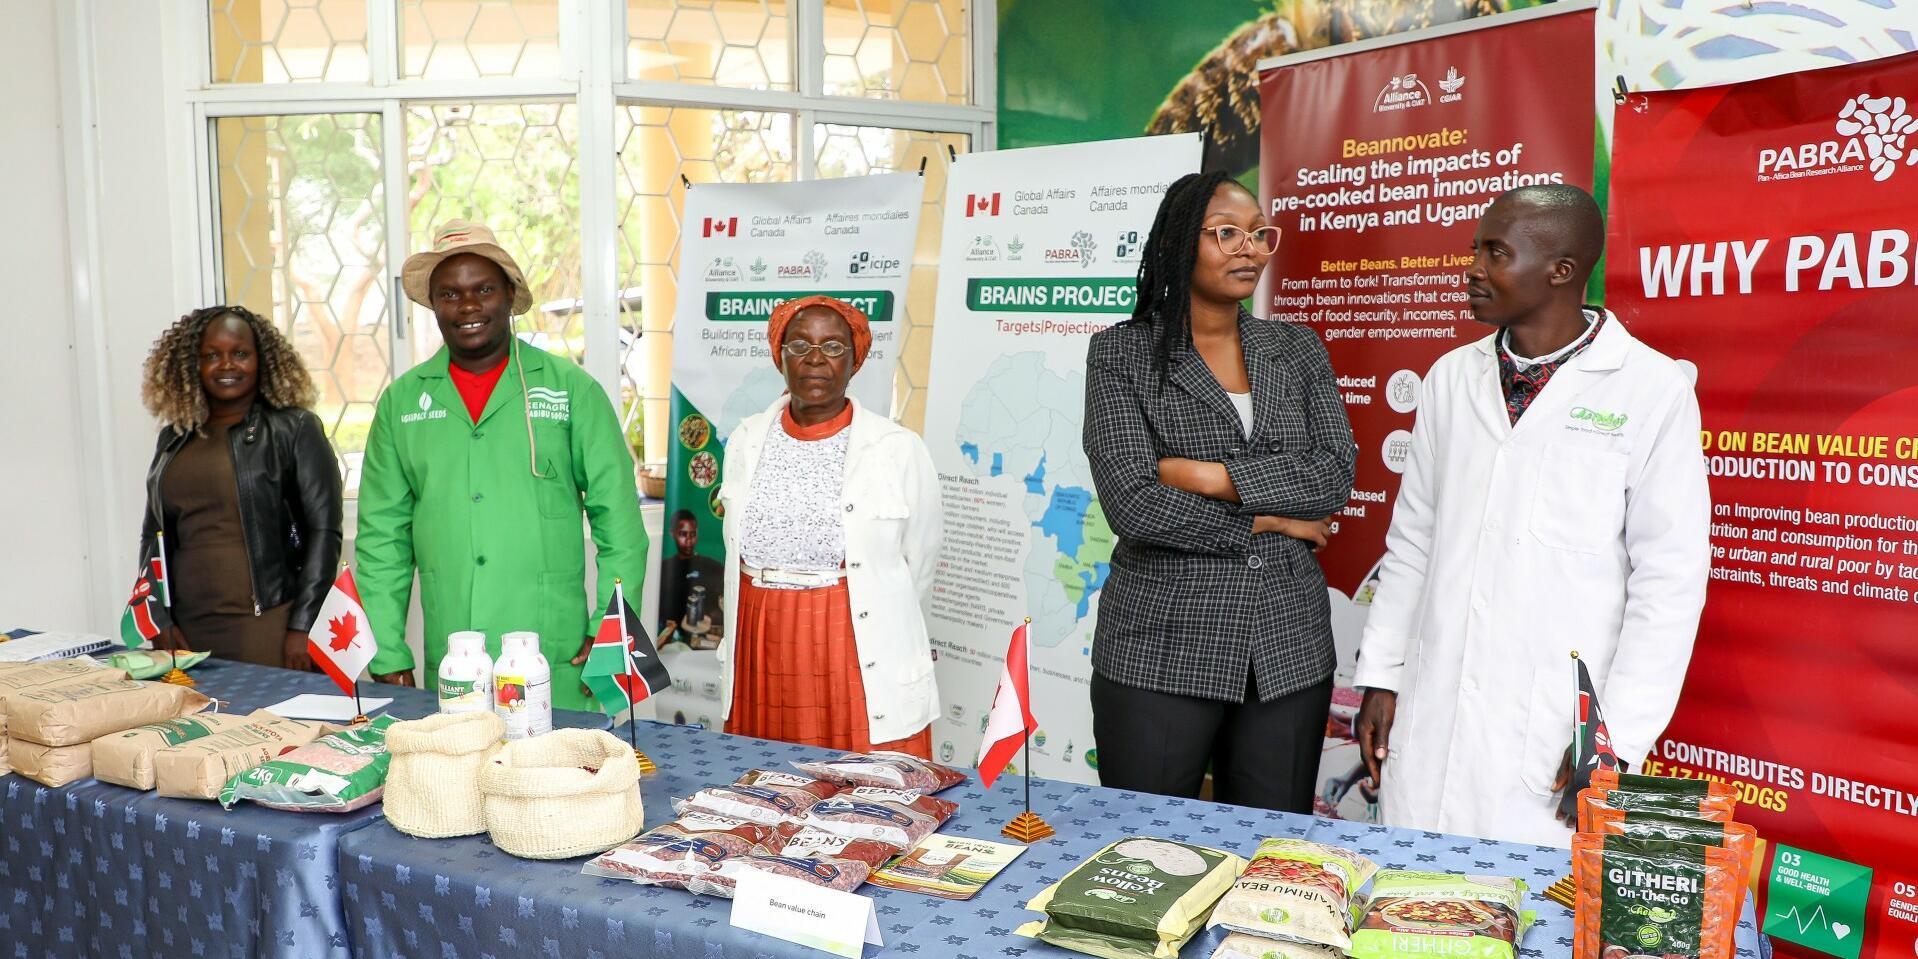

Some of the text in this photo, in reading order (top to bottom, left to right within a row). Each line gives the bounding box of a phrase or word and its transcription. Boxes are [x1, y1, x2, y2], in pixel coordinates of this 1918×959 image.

[1384, 91, 1421, 104] Alliance
[1342, 127, 1468, 158] Beannovate:
[1296, 143, 1523, 186] Scaling the impacts of
[1759, 138, 1865, 173] PABRA
[1806, 168, 1836, 176] Research
[1837, 164, 1863, 172] Alliance
[1015, 190, 1043, 201] Global
[1046, 189, 1076, 199] Affairs
[1091, 185, 1127, 197] Affaires
[1272, 170, 1564, 216] pre-cooked bean innovations
[1013, 200, 1128, 215] Canada Canada
[752, 211, 909, 225] Global Affairs Affaires mondiales
[1300, 213, 1316, 232] in
[1320, 212, 1379, 233] Kenya
[1383, 204, 1421, 226] and
[750, 225, 859, 237] Canada Canada
[1045, 249, 1079, 259] PABRA
[778, 266, 811, 274] PABRA
[870, 256, 900, 273] icipe
[1321, 260, 1358, 272] Better
[1360, 258, 1398, 271] Beans.
[1401, 256, 1440, 269] Better
[1640, 229, 1918, 299] WHY PAB
[1282, 278, 1308, 290] From
[1312, 277, 1337, 289] farm
[1340, 277, 1352, 288] to
[1354, 275, 1379, 289] fork!
[1381, 272, 1460, 287] Transforming
[979, 286, 1048, 305] BRAINS
[1274, 293, 1314, 309] through
[1316, 293, 1344, 305] bean
[1347, 292, 1411, 305] innovations
[1414, 291, 1438, 303] that
[1269, 311, 1308, 321] impacts
[1311, 309, 1323, 322] of
[1326, 309, 1351, 321] food
[702, 329, 744, 341] Building
[1325, 326, 1366, 341] gender
[710, 346, 772, 358] African Bea
[1345, 392, 1371, 404] time
[1718, 431, 1747, 452] ON
[1752, 432, 1809, 454] BEAN
[1816, 434, 1889, 458] VALUE
[1822, 461, 1850, 484] TO
[1343, 506, 1365, 517] and
[1714, 503, 1730, 516] on
[1735, 502, 1800, 525] Improving
[1805, 508, 1839, 526] bean
[1711, 522, 1748, 539] trition
[1752, 528, 1777, 542] and
[1781, 532, 1872, 552] consumption
[1877, 537, 1904, 554] for
[1729, 547, 1767, 563] urban
[1771, 552, 1797, 566] and
[1800, 554, 1833, 571] rural
[1837, 560, 1872, 575] poor
[1875, 560, 1894, 580] by
[1768, 571, 1818, 591] threats
[1821, 580, 1849, 595] and
[1853, 583, 1909, 602] climate
[1663, 739, 1804, 790] CONTRIBUTES
[249, 768, 274, 784] 2Kg
[759, 774, 810, 785] BEANS
[1781, 852, 1801, 866] 03
[1088, 875, 1155, 895] Yellow
[1100, 868, 1166, 888] Beans
[1608, 868, 1698, 893] GITHERI
[1778, 866, 1829, 886] GOOD HEALTH
[1783, 877, 1831, 896] WELL-BEING
[1894, 882, 1916, 898] 05
[1617, 887, 1688, 905] On-The-Go
[770, 899, 825, 919] Bean value chain
[1392, 937, 1472, 955] GITHERI
